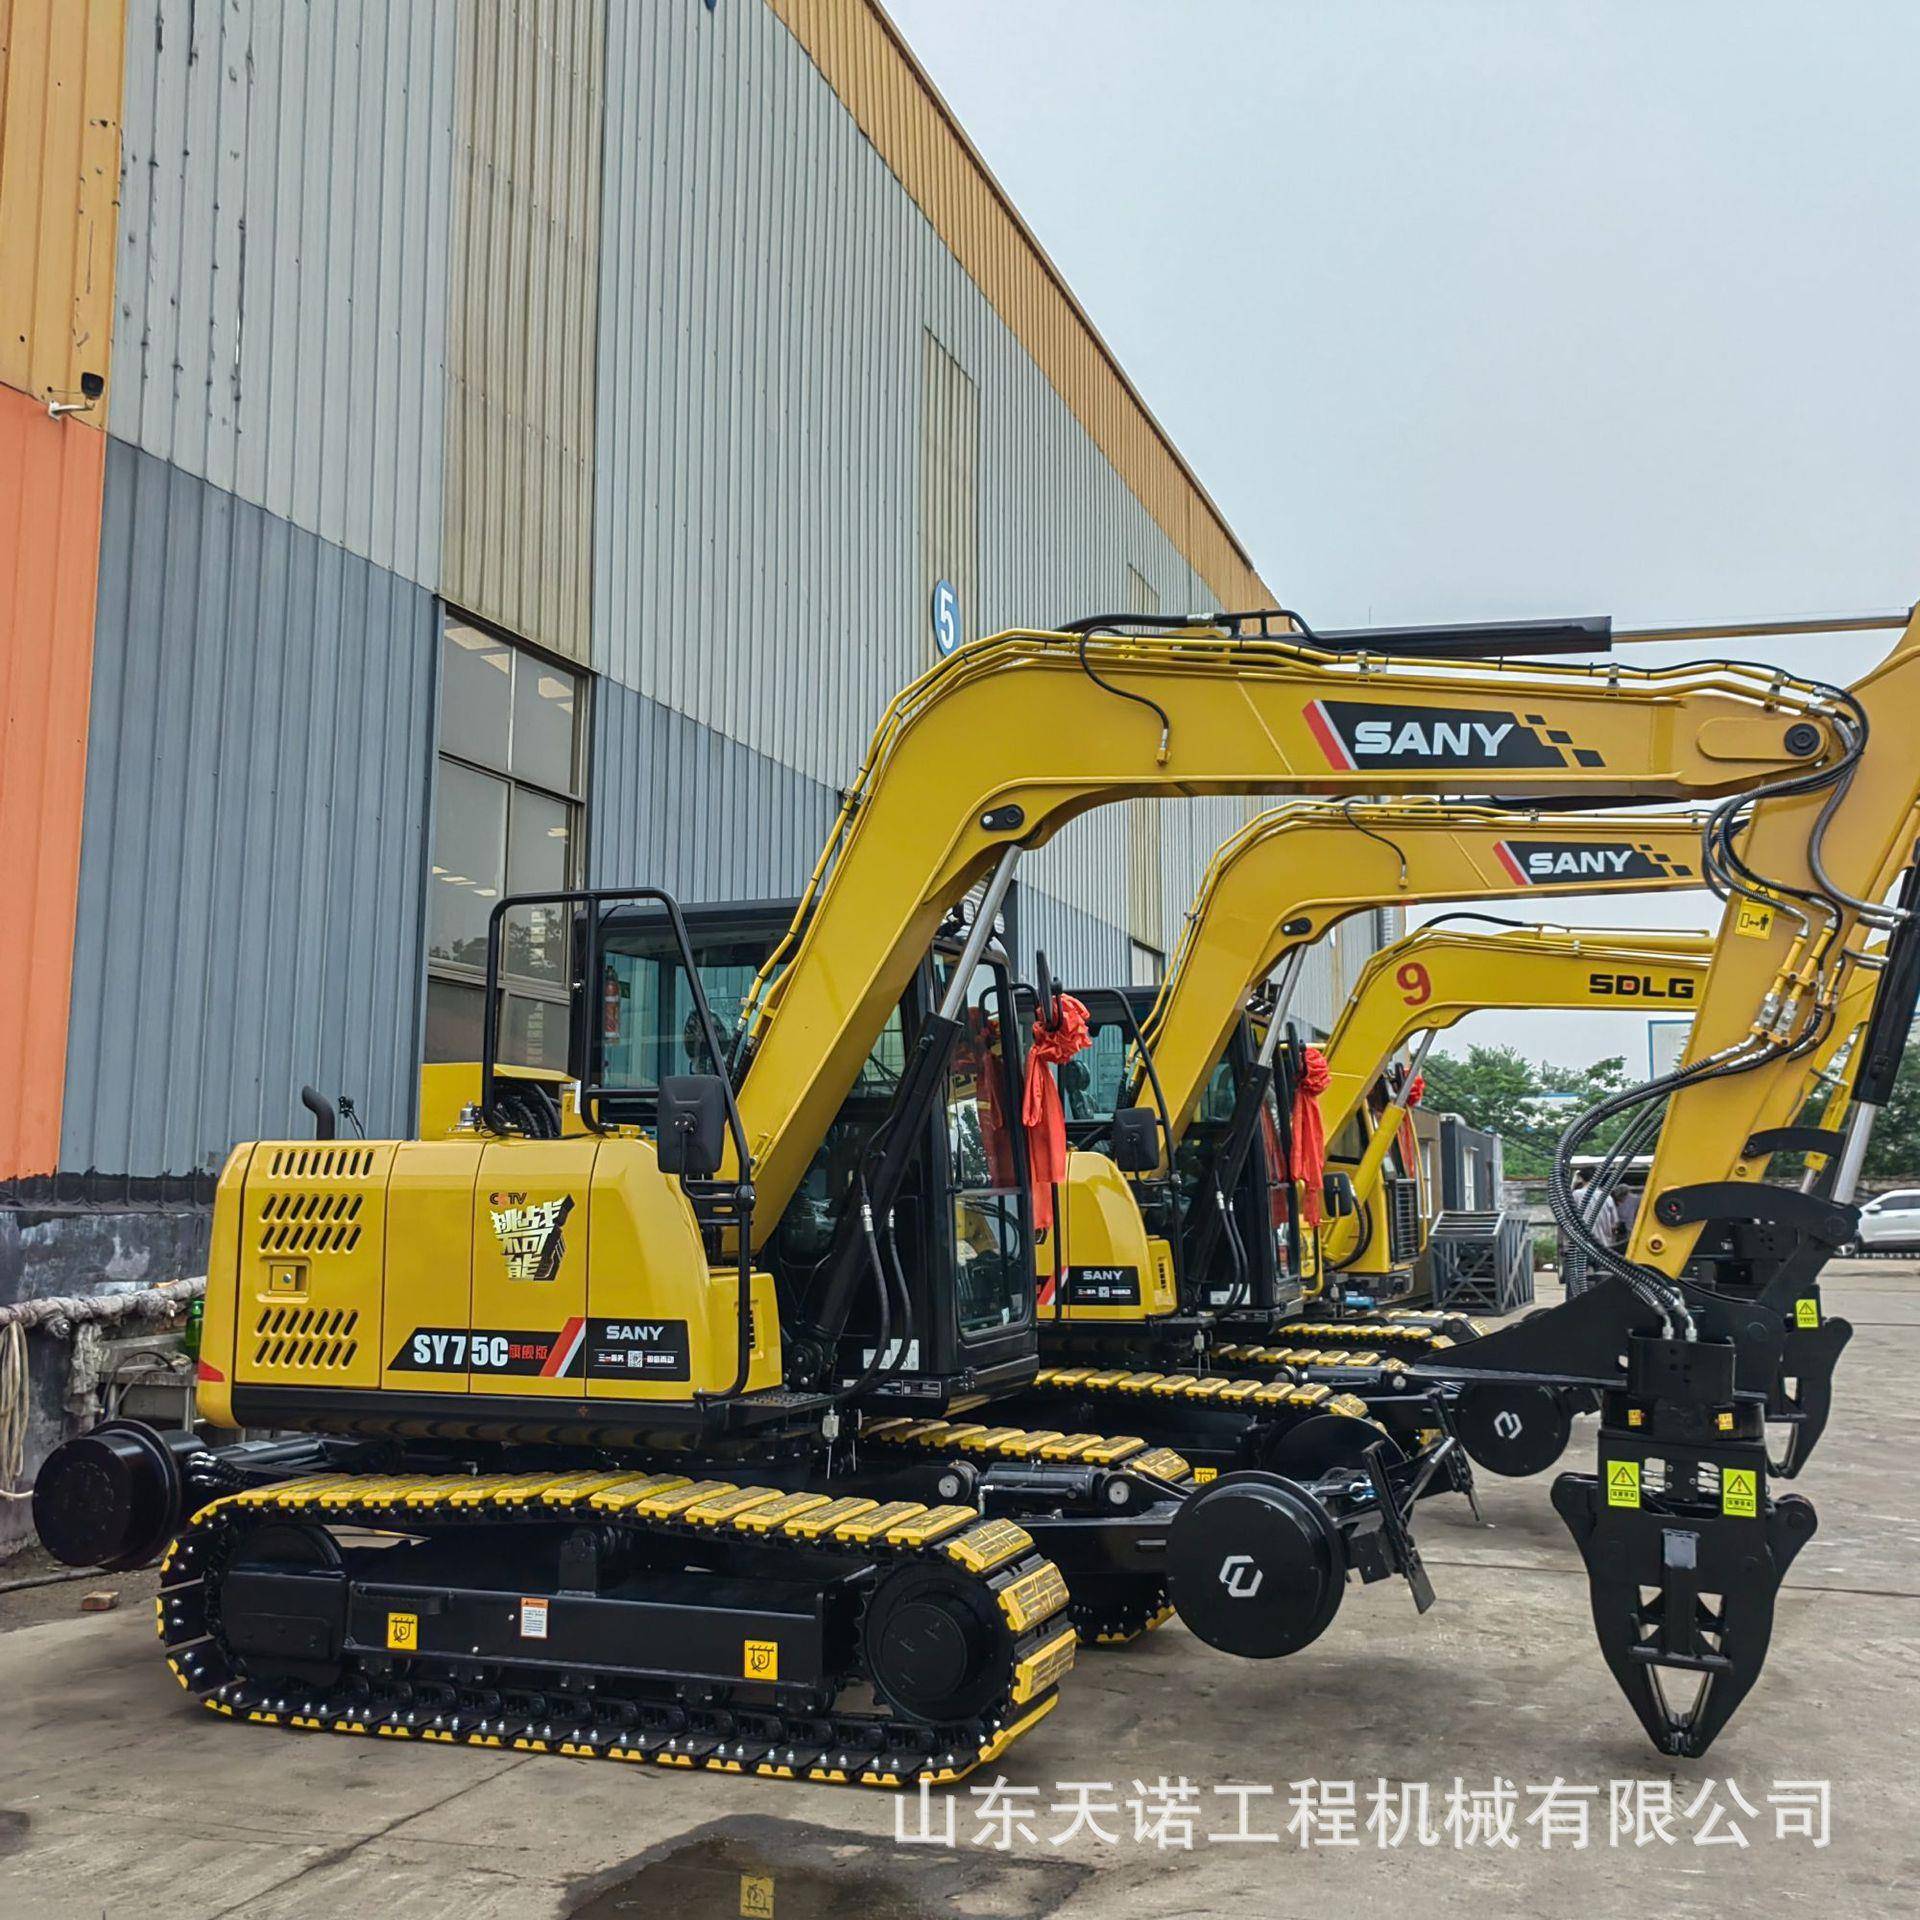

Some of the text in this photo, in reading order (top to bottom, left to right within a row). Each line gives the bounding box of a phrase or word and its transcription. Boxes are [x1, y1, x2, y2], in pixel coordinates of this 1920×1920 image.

[940, 587, 954, 650] 5
[1355, 721, 1515, 757] SANY
[1529, 850, 1633, 875] SANY
[1396, 962, 1432, 1006] 9
[1589, 973, 1695, 999] SDLG
[1082, 1270, 1123, 1281] SANY
[606, 1325, 664, 1341] SANY
[413, 1334, 509, 1367] SY75C
